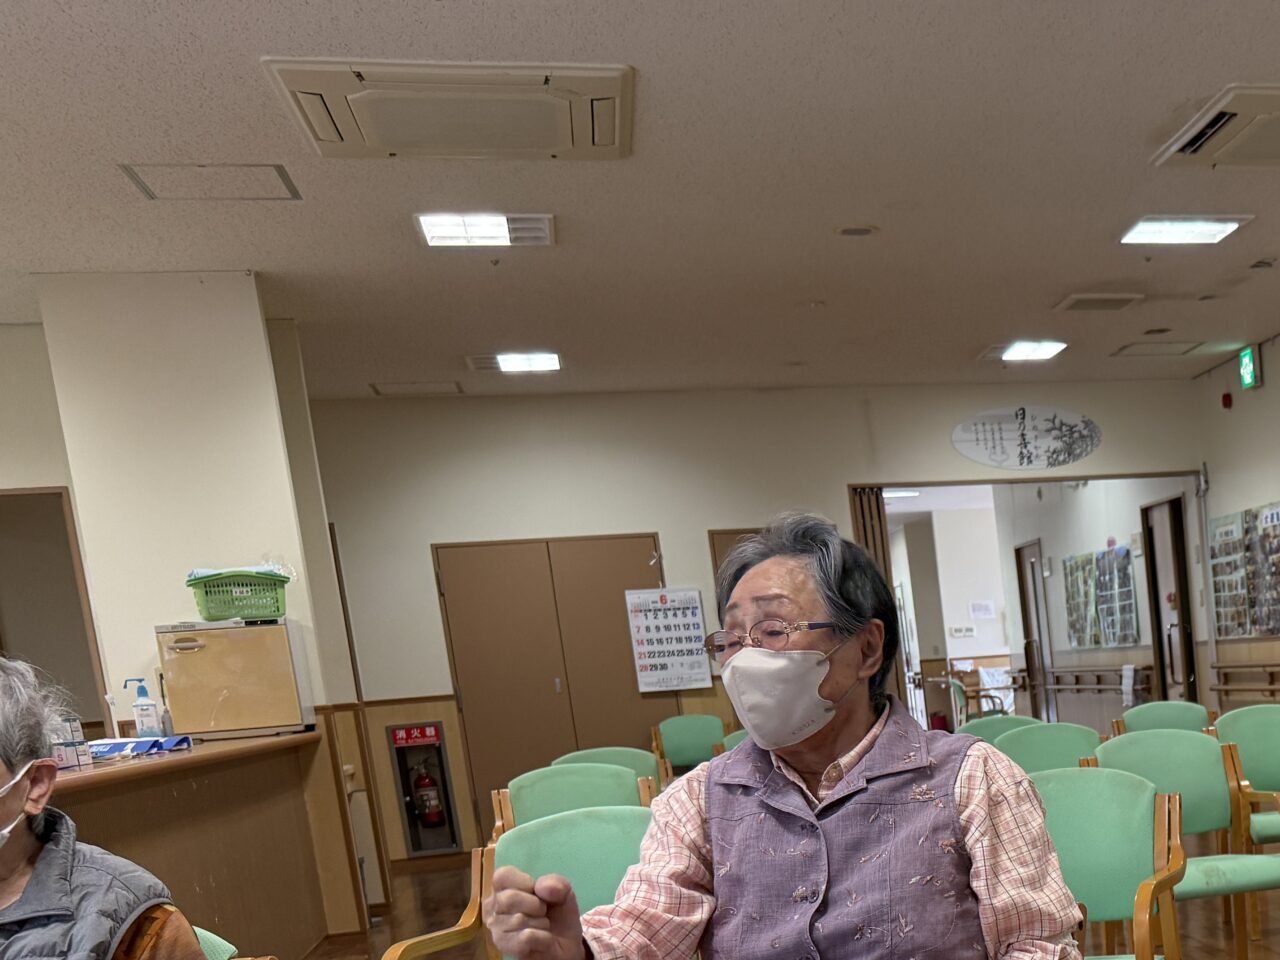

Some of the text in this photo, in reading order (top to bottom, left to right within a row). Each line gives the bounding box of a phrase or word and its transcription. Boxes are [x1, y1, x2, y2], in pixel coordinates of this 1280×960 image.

[659, 594, 667, 605] 6
[635, 625, 641, 633] 7
[645, 625, 651, 633] 8
[663, 624, 671, 632] 10
[683, 623, 690, 631] 12
[675, 636, 683, 644] 18
[639, 663, 668, 672] 28 29 30
